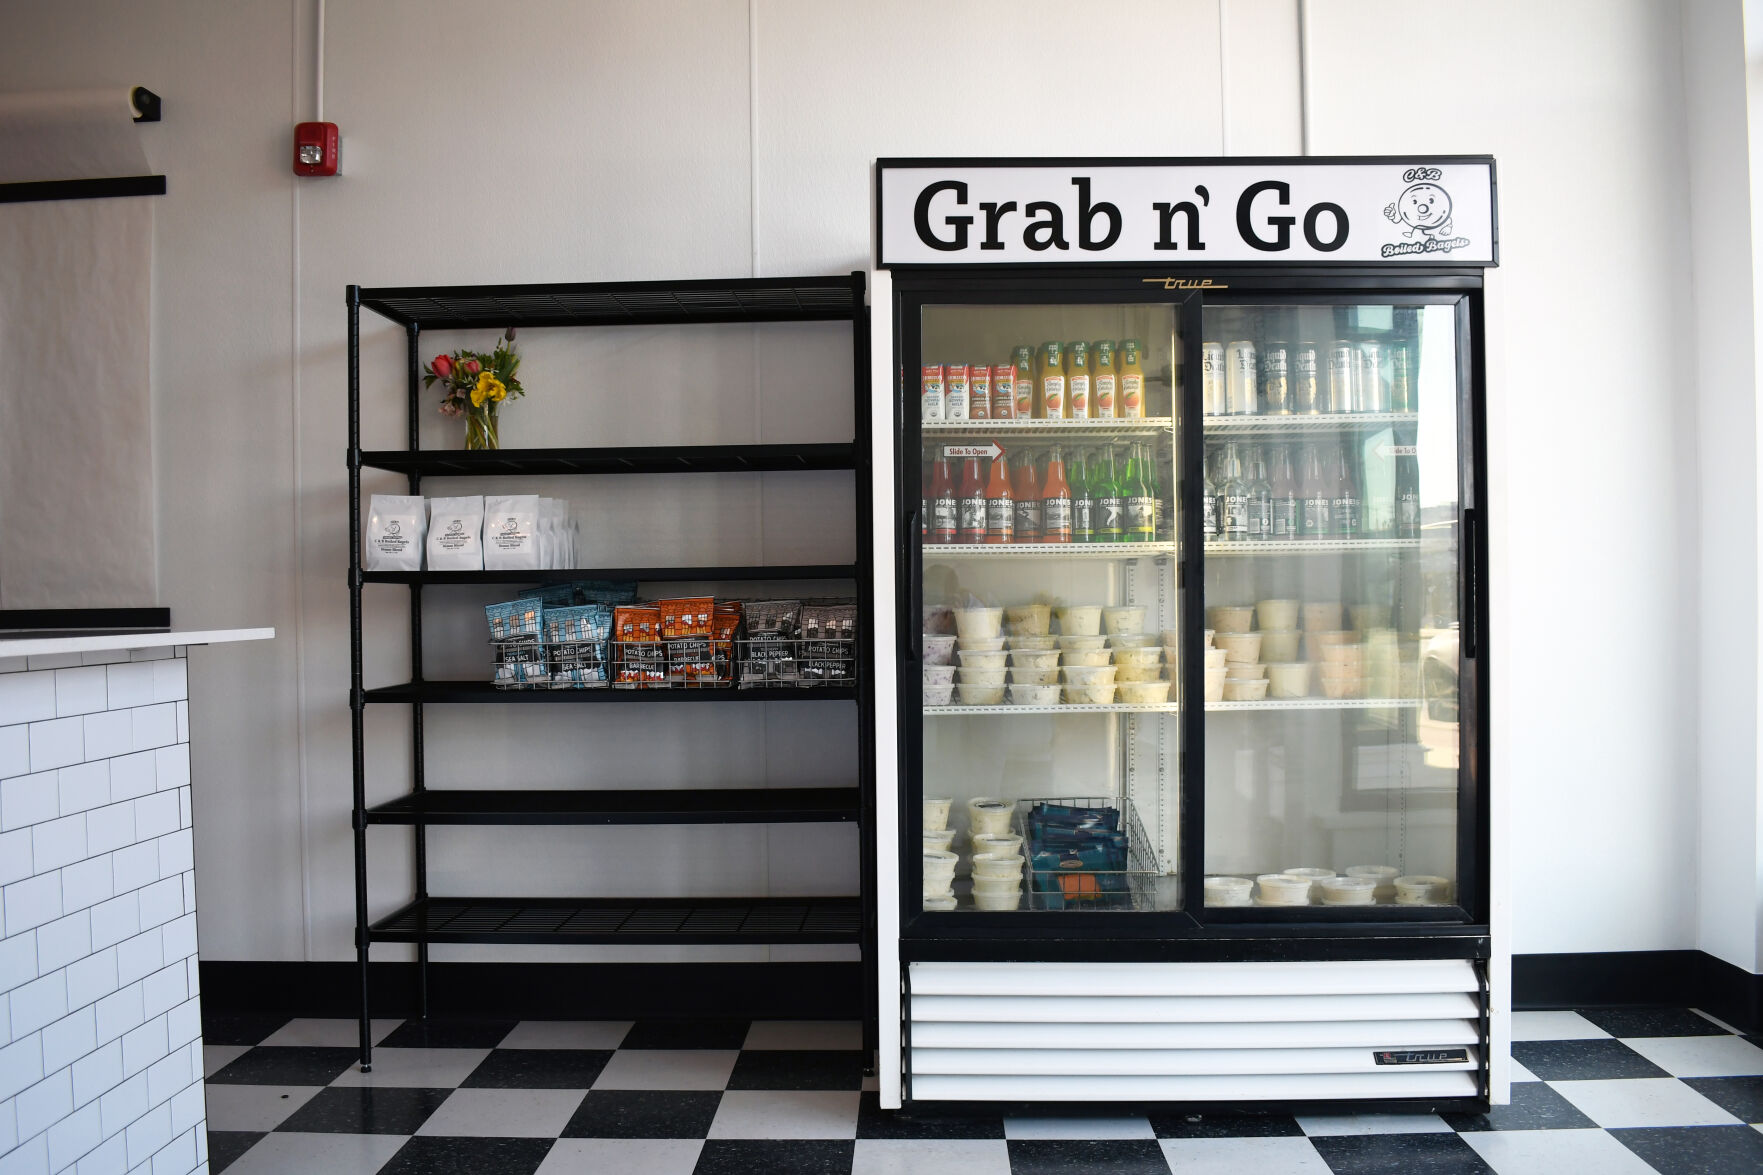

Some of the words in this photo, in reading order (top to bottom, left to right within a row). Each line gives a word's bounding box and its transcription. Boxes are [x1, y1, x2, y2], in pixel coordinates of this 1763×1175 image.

[1403, 167, 1443, 183] C&B
[913, 177, 1123, 252] Grab
[1236, 180, 1350, 252] Go
[1381, 242, 1425, 258] Boiled
[1424, 237, 1470, 253] Bagels
[1142, 277, 1228, 289] true
